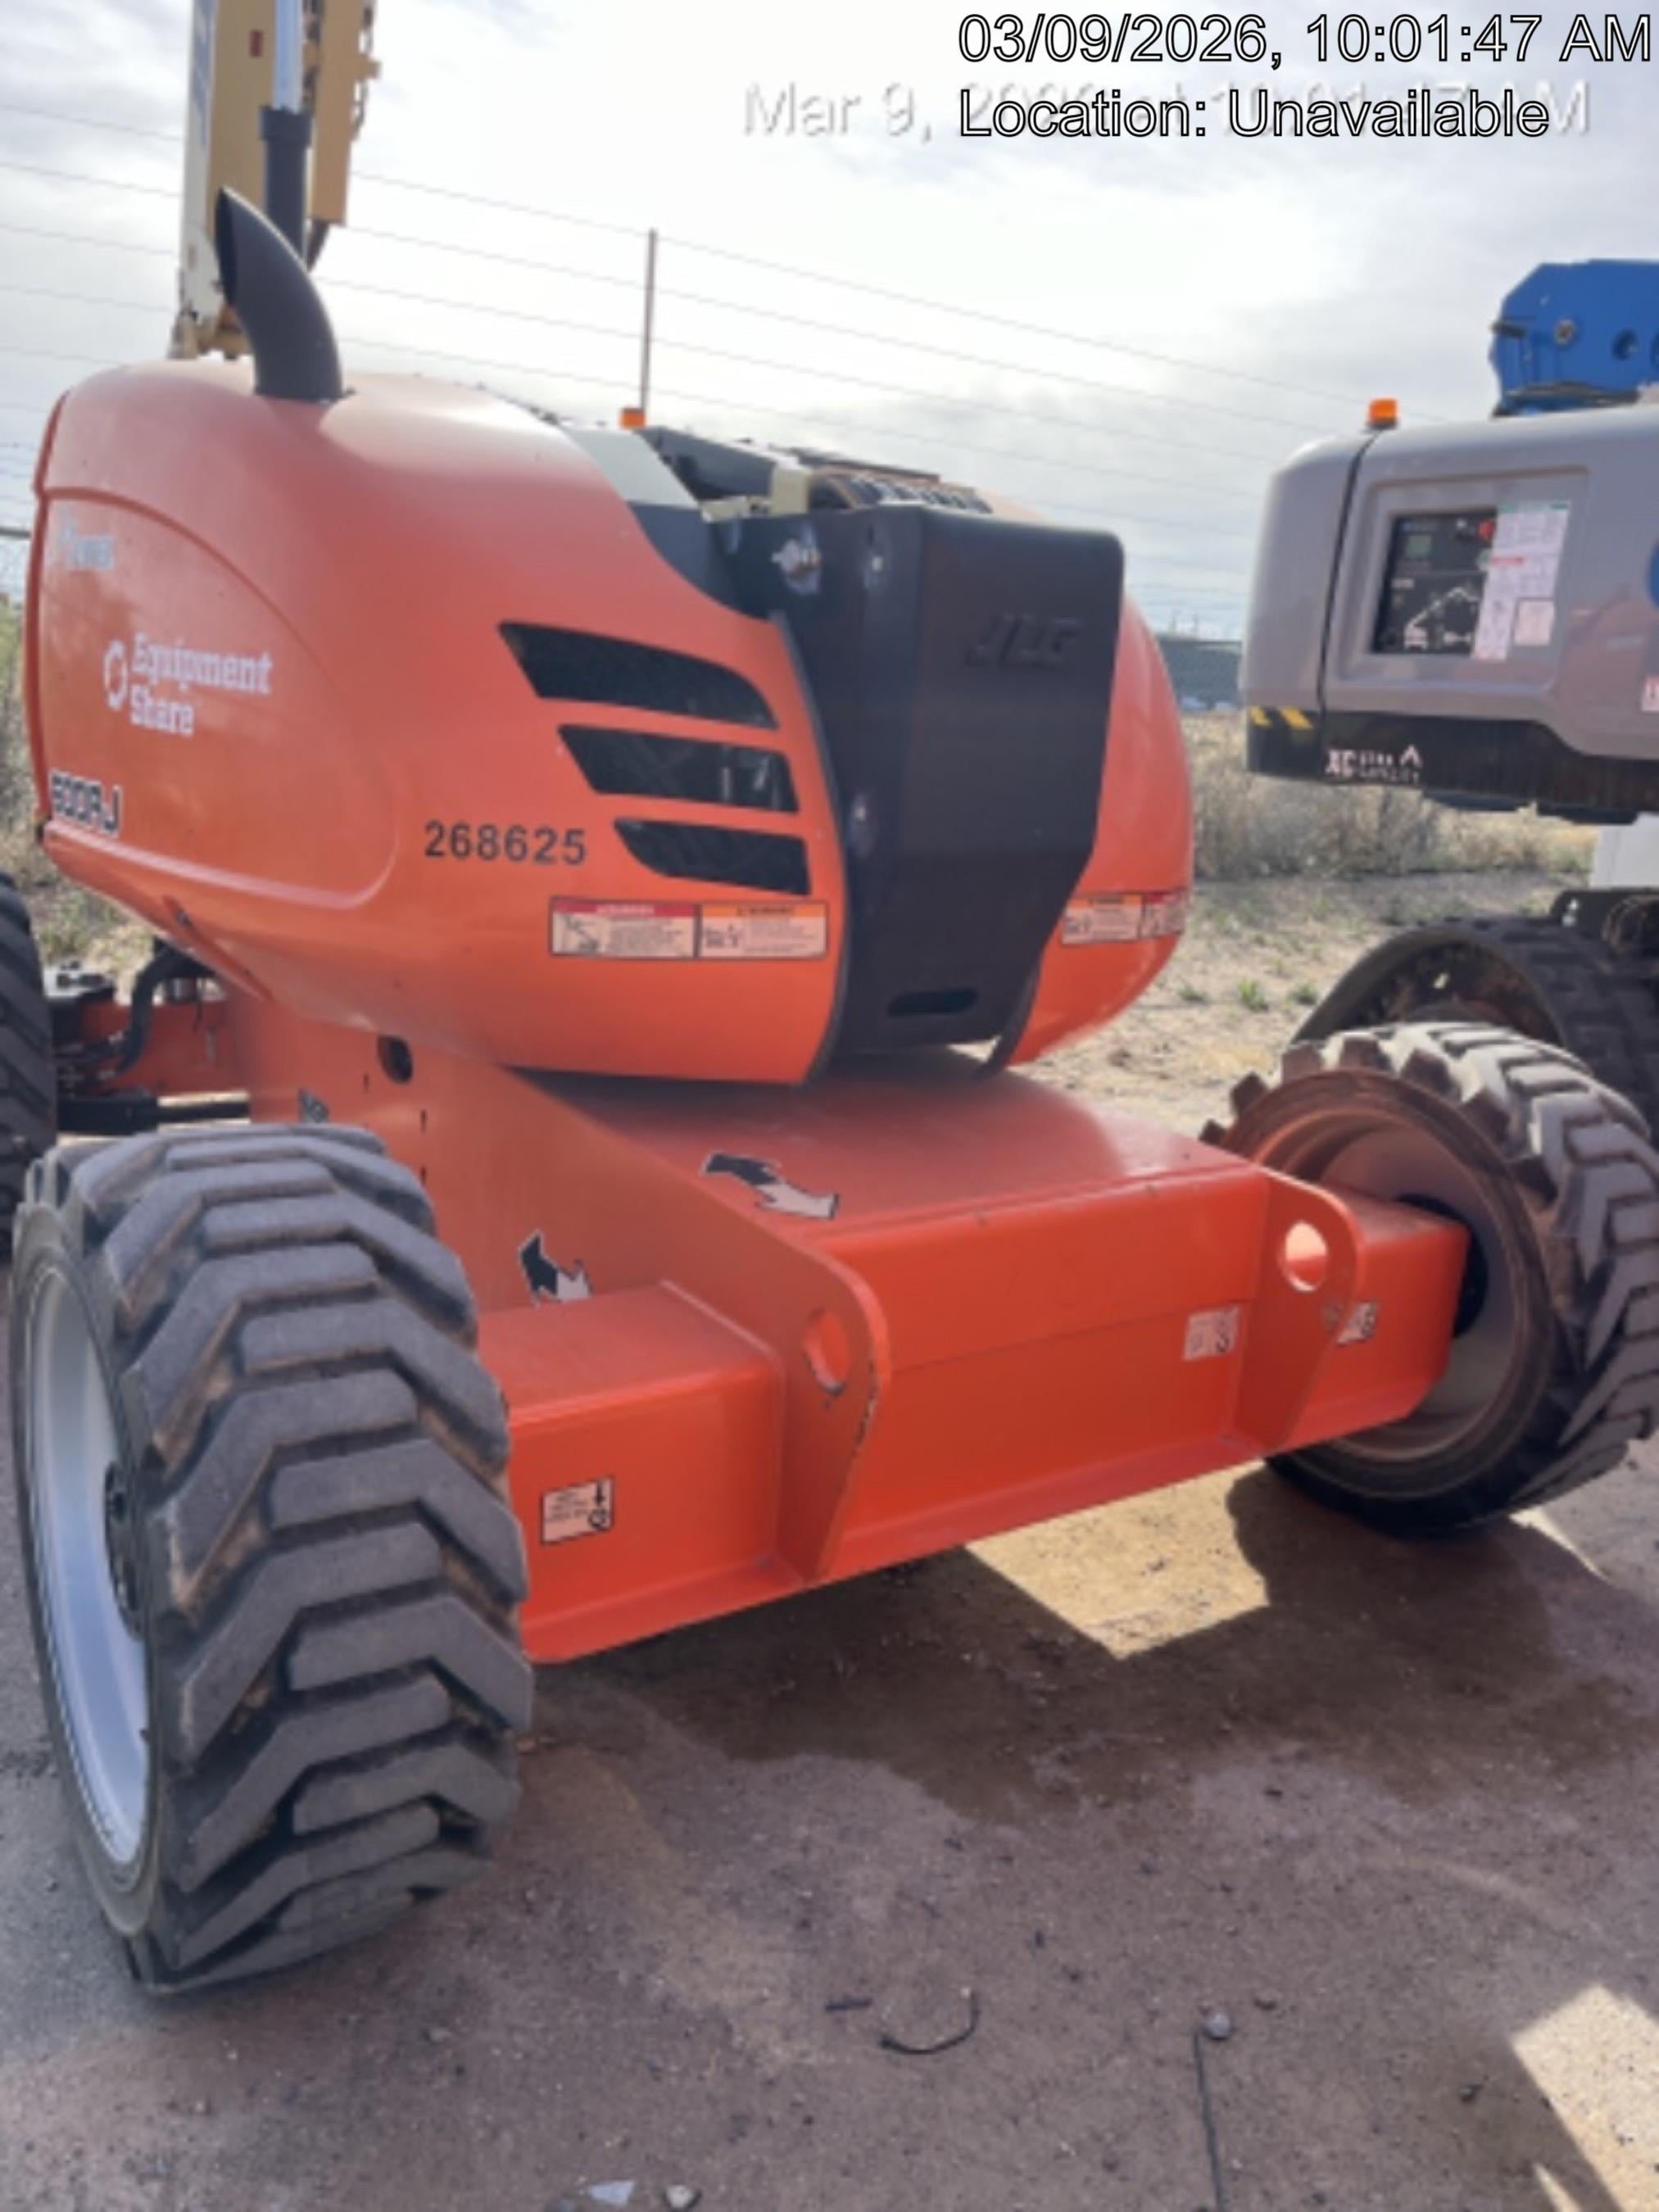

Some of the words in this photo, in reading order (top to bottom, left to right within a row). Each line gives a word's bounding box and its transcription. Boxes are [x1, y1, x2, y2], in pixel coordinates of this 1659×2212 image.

[133, 632, 272, 695] Equipment
[129, 684, 194, 737] Share
[424, 819, 587, 865] 268625
